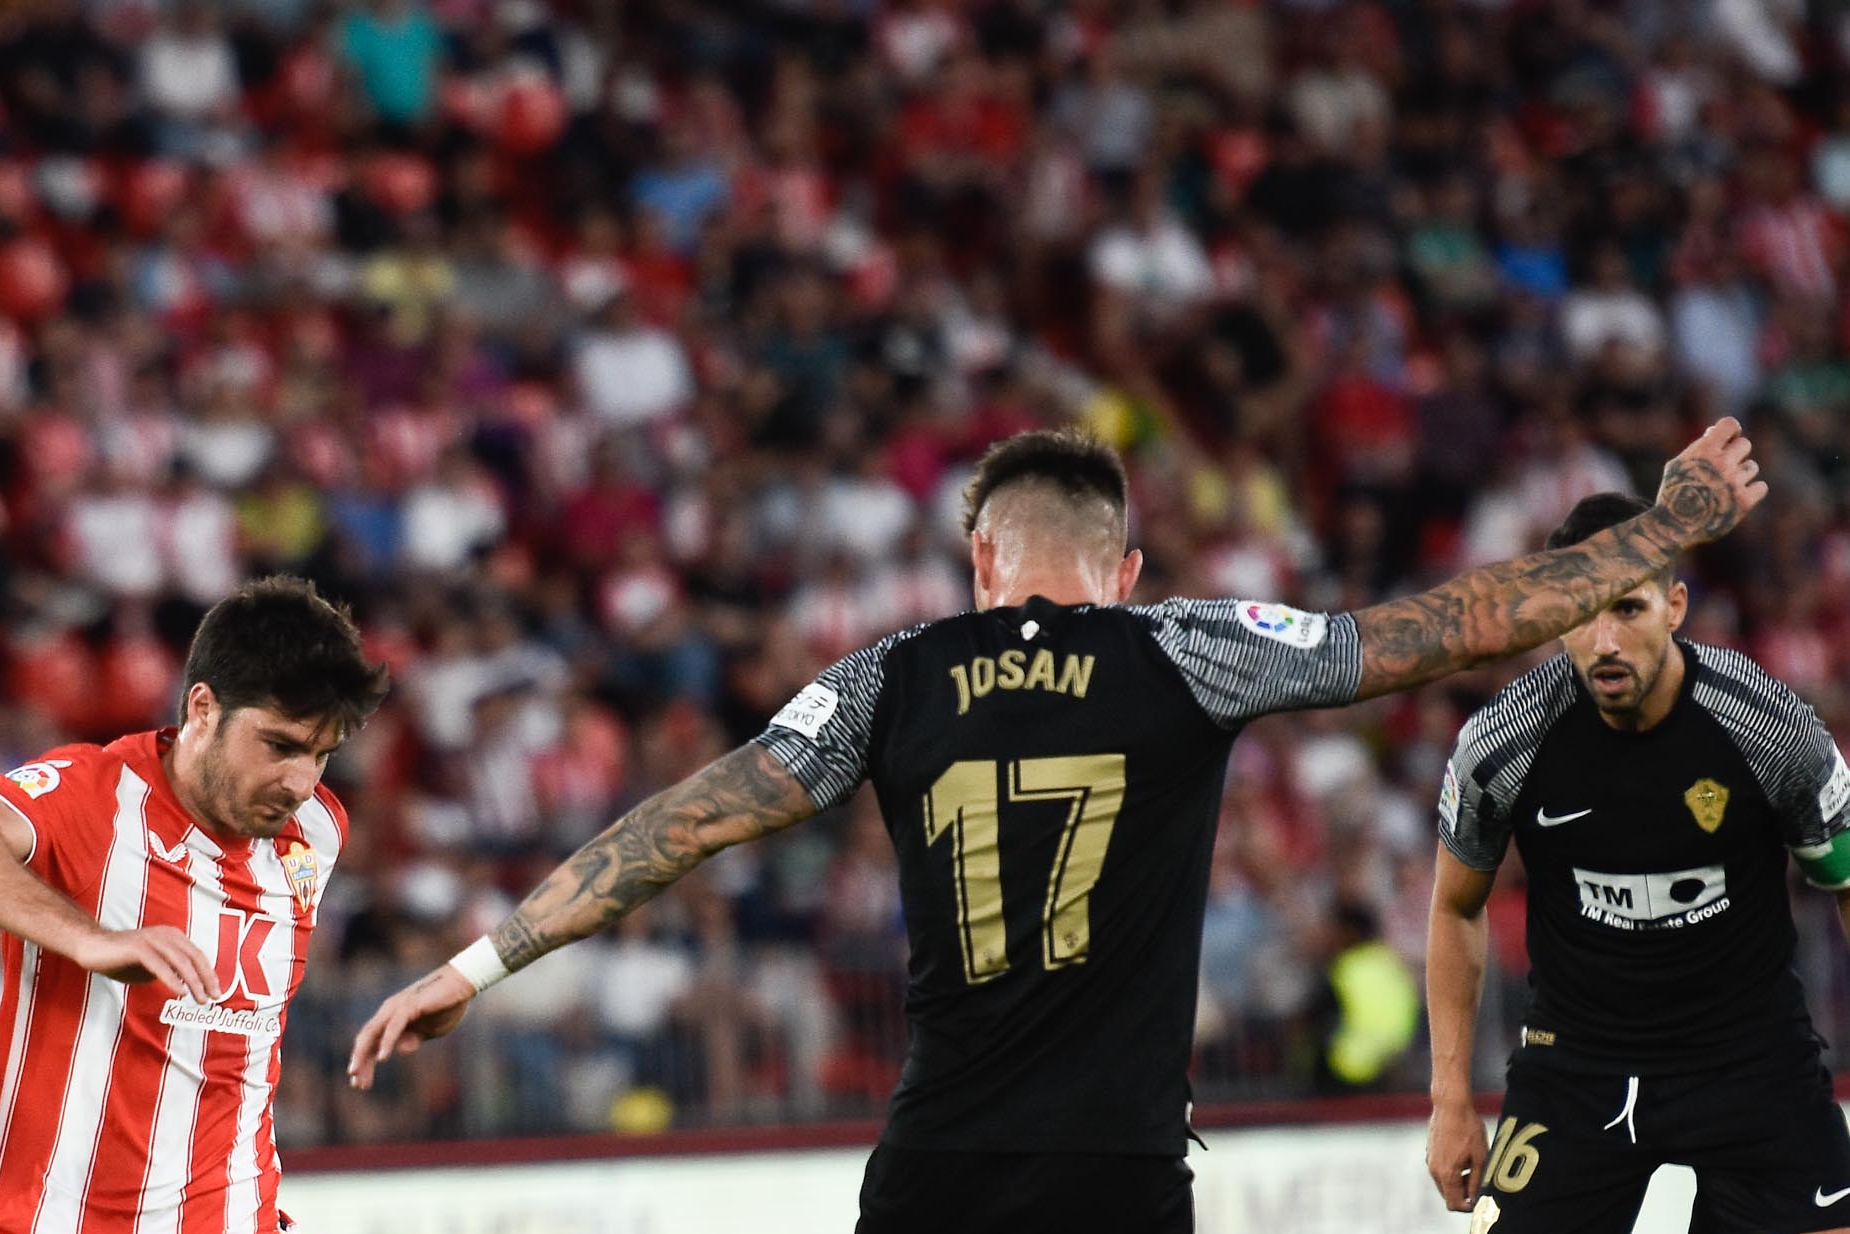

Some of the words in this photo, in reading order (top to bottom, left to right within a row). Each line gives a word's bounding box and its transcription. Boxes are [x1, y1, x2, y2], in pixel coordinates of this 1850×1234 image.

[950, 648, 1095, 716] JOSAN
[922, 753, 1126, 984] 17
[1583, 880, 1634, 910] TM
[1685, 897, 1731, 925] Group
[165, 1004, 217, 1025] Khaled
[219, 1008, 264, 1032] Juffali
[1480, 1115, 1549, 1194] 16
